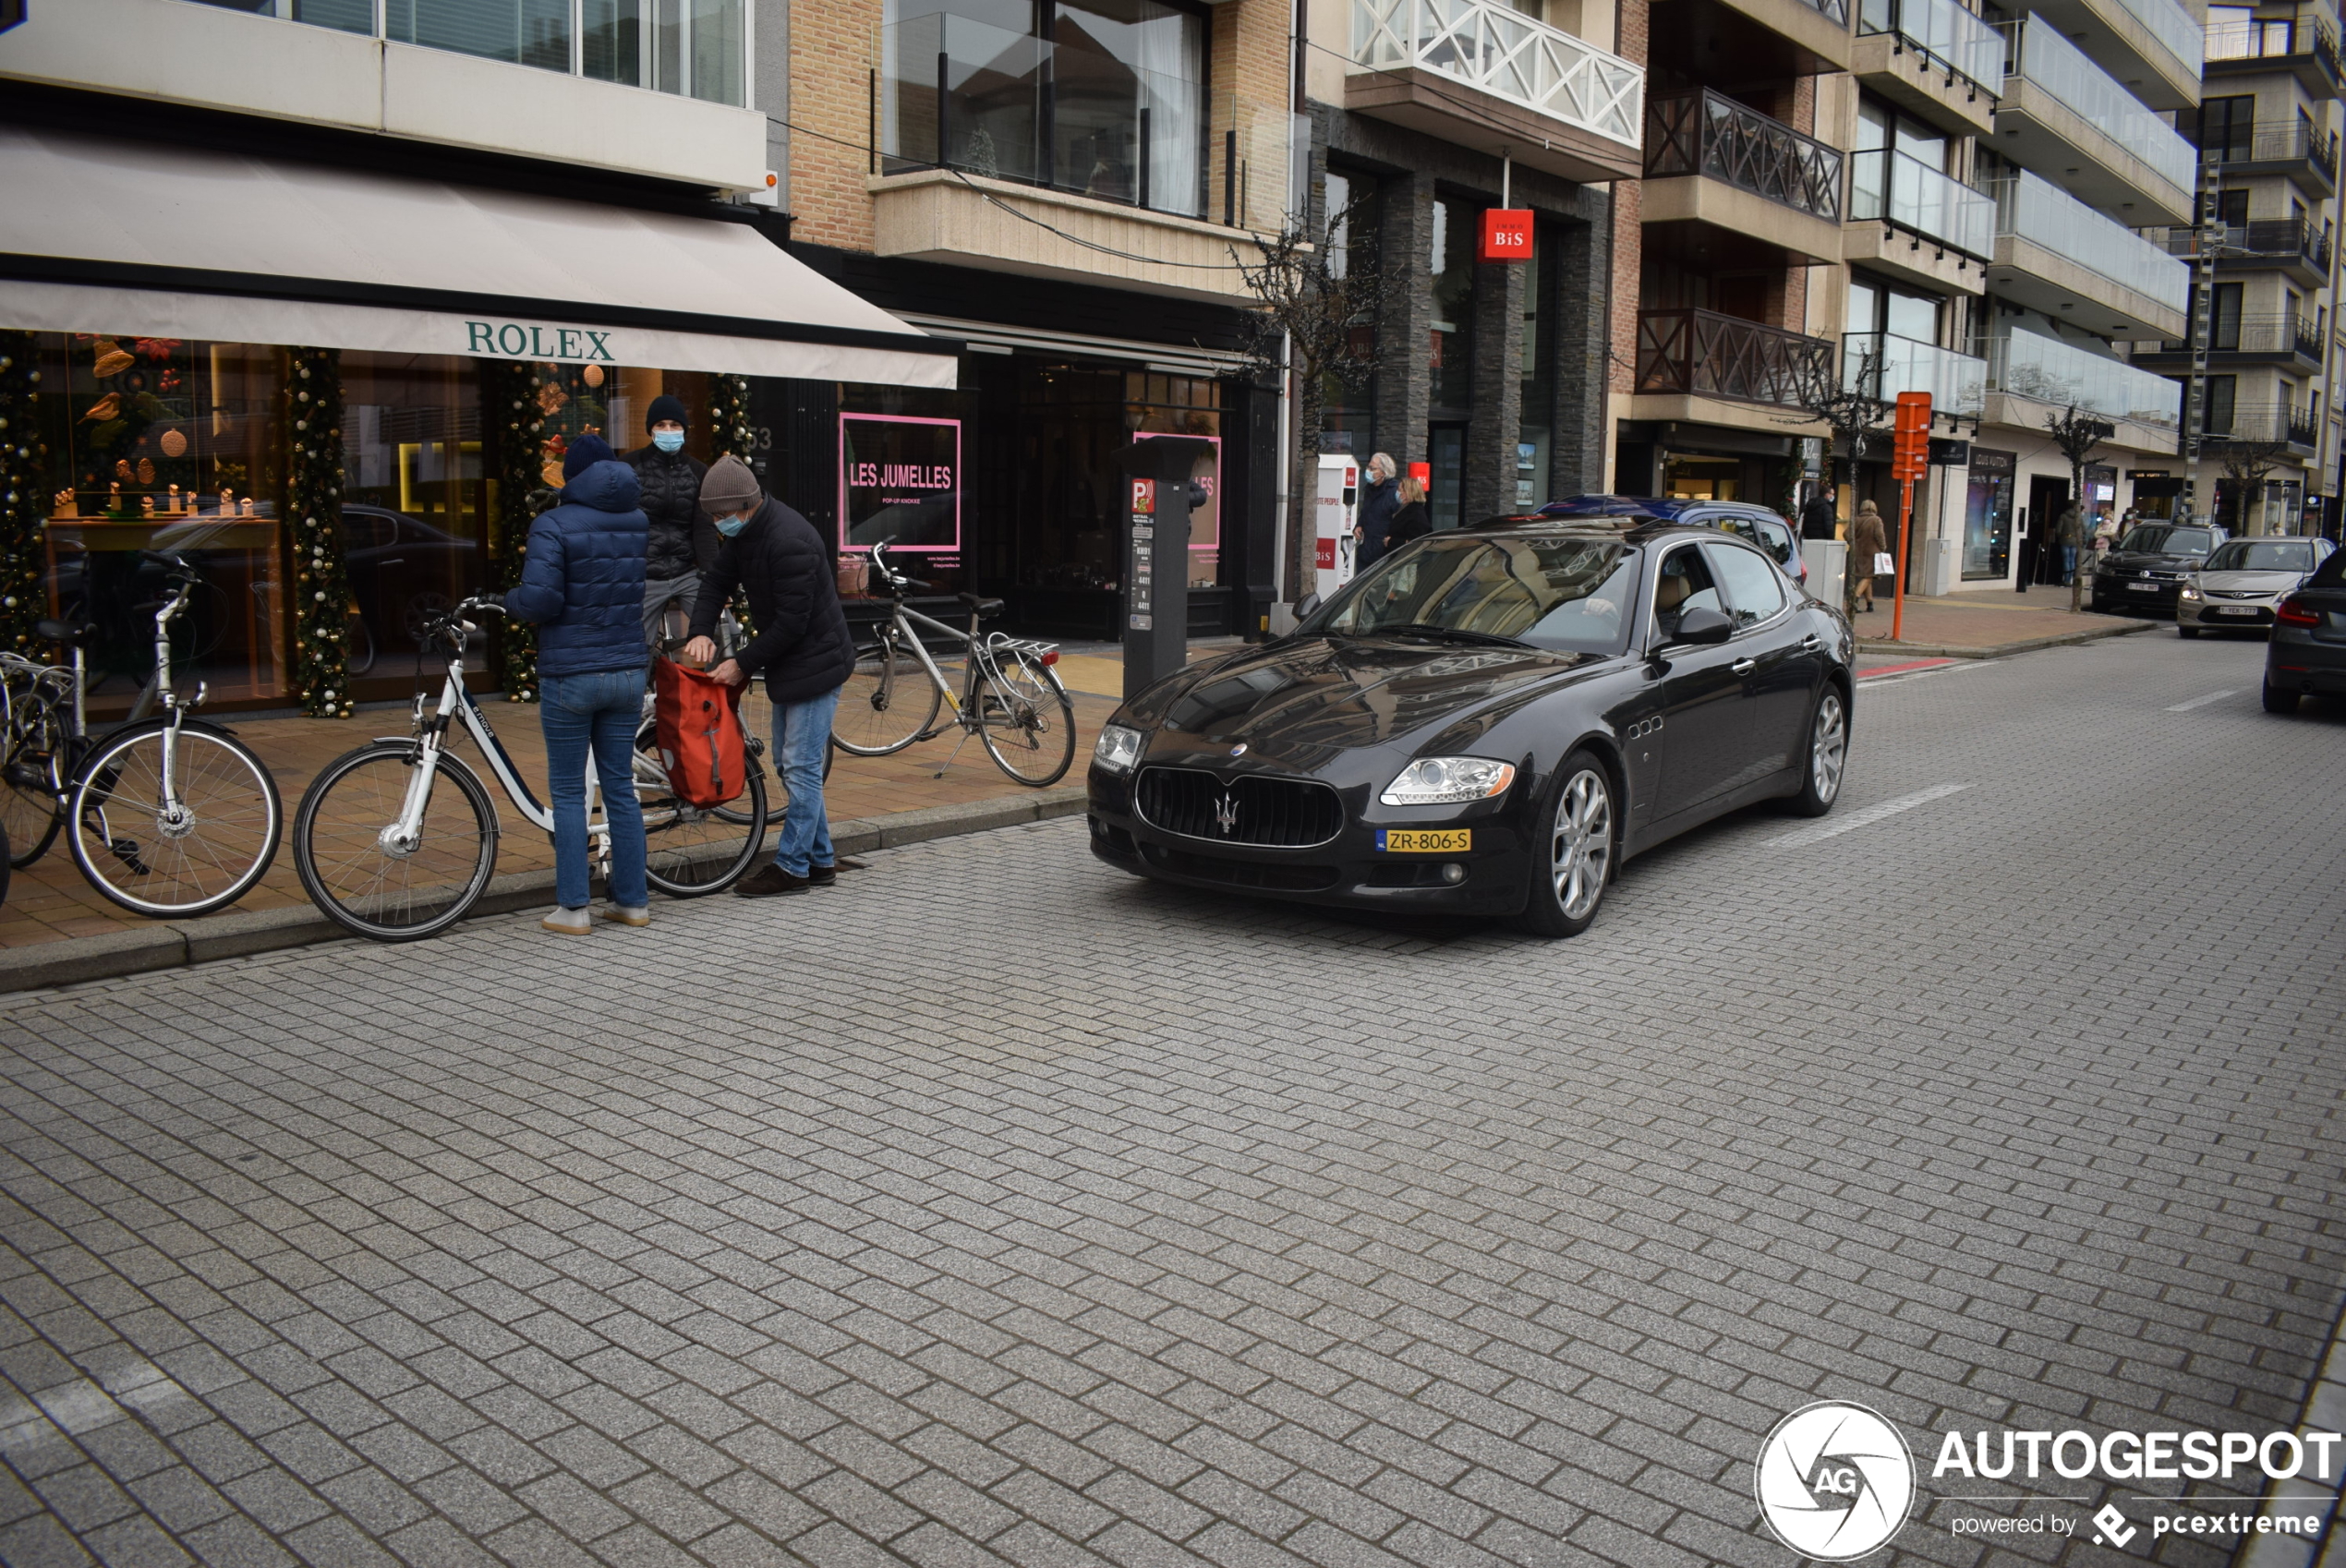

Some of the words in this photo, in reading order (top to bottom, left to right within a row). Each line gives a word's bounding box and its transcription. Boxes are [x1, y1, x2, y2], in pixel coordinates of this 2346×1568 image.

[1494, 232, 1523, 246] BiS
[465, 321, 615, 361] ROLEX
[850, 463, 877, 487] LES
[880, 464, 951, 488] JUMELLES
[1133, 482, 1146, 508] P
[1390, 833, 1467, 849] ZR-806-S
